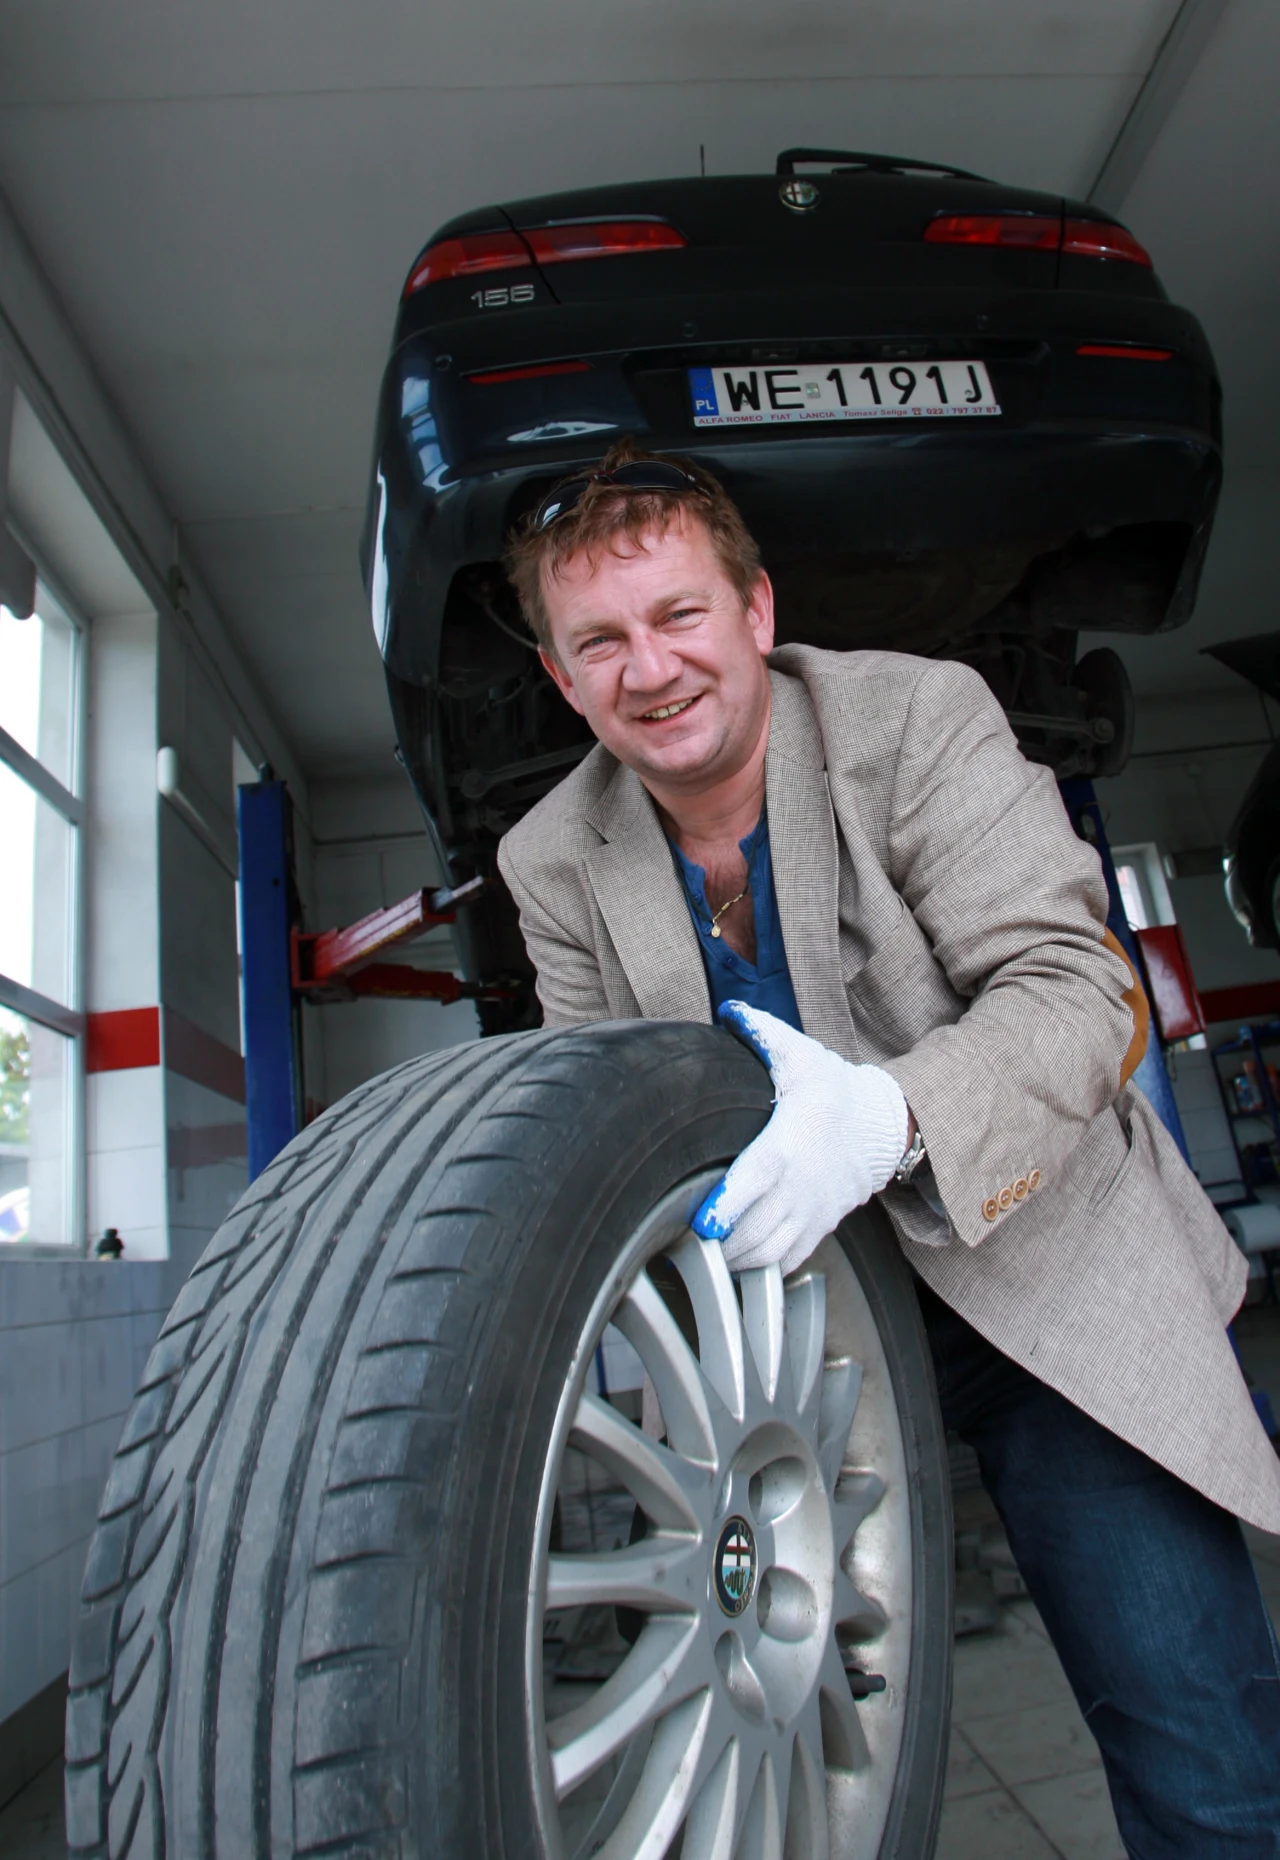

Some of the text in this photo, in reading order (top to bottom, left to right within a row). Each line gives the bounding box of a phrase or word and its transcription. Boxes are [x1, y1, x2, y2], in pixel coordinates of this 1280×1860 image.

[471, 284, 535, 308] 156
[723, 364, 982, 412] WE 1191J
[695, 399, 715, 411] PL
[698, 416, 725, 425] ALFA
[726, 415, 763, 423] ROMEO
[770, 413, 792, 421] FIAT
[799, 411, 836, 420] LANCIA
[926, 407, 944, 415] 022
[972, 406, 982, 414] 37
